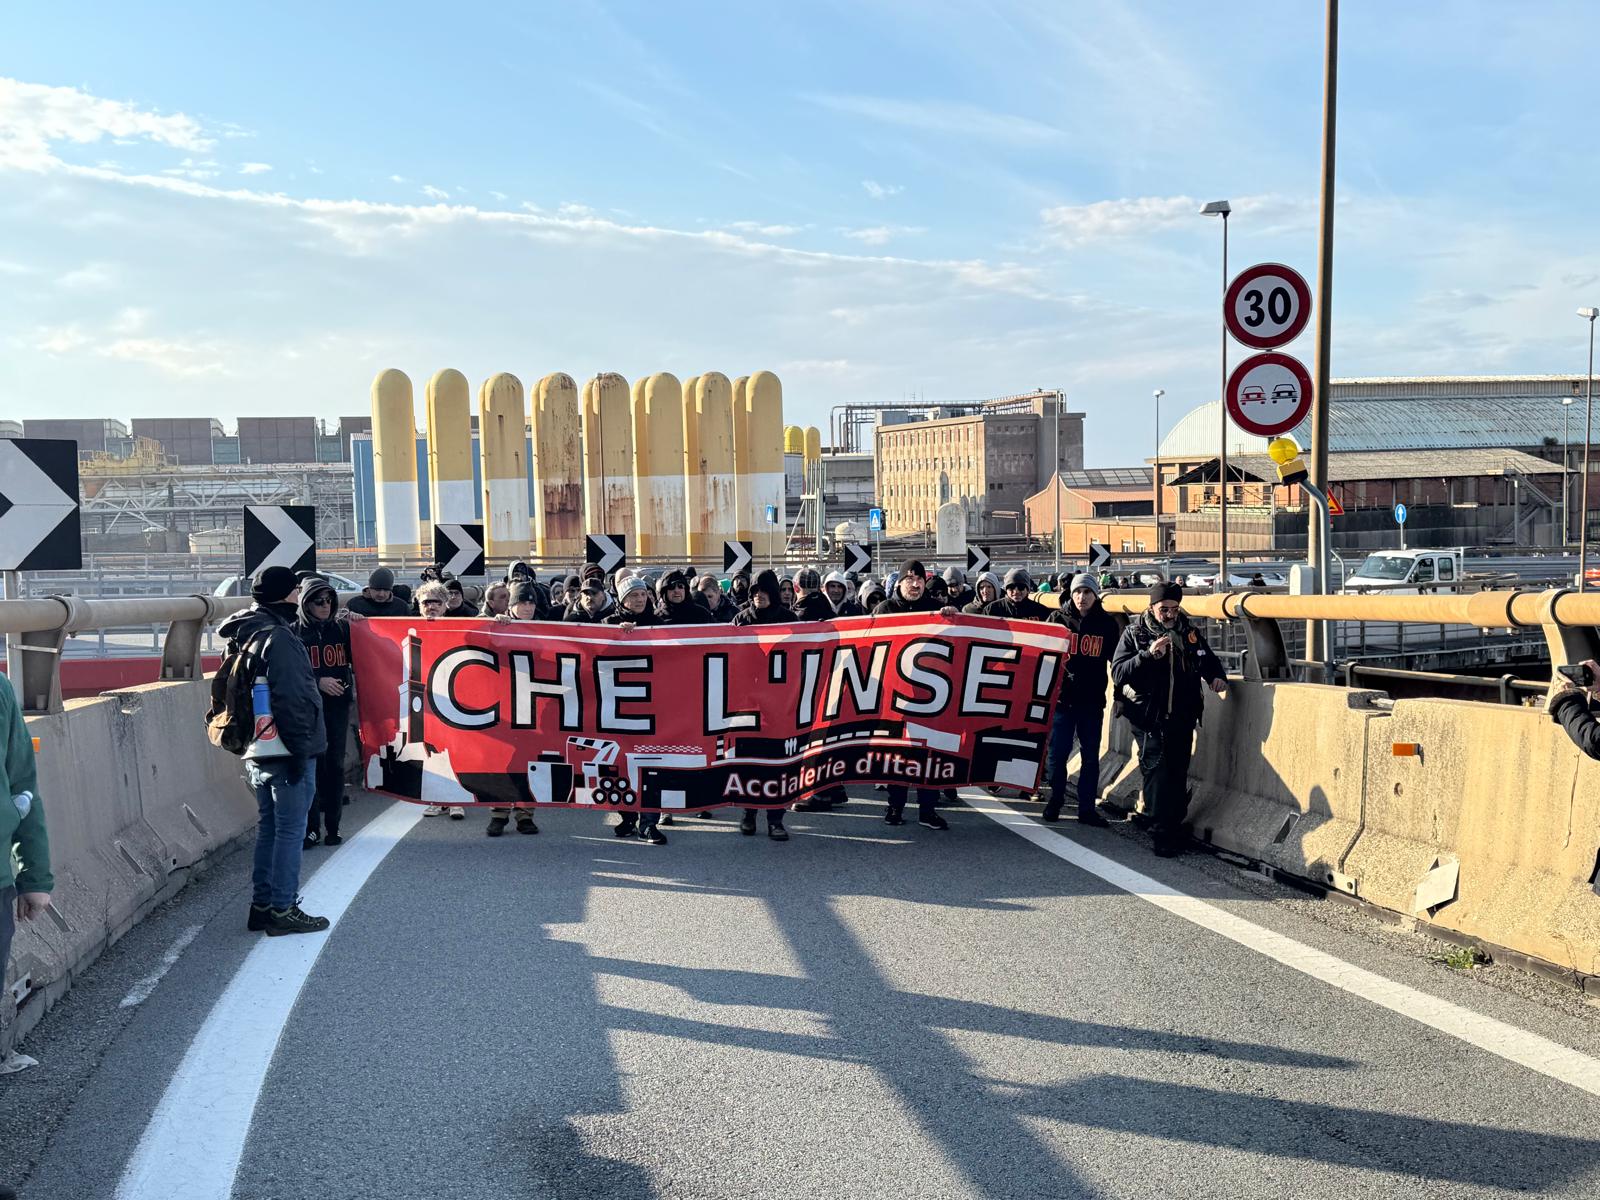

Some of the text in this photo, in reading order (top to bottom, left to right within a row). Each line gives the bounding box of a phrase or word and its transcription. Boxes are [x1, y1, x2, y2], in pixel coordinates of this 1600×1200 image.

[1244, 286, 1292, 327] 30
[428, 637, 1062, 736] CHE L'INSE!
[722, 751, 956, 797] Acciaierie d'Italia
